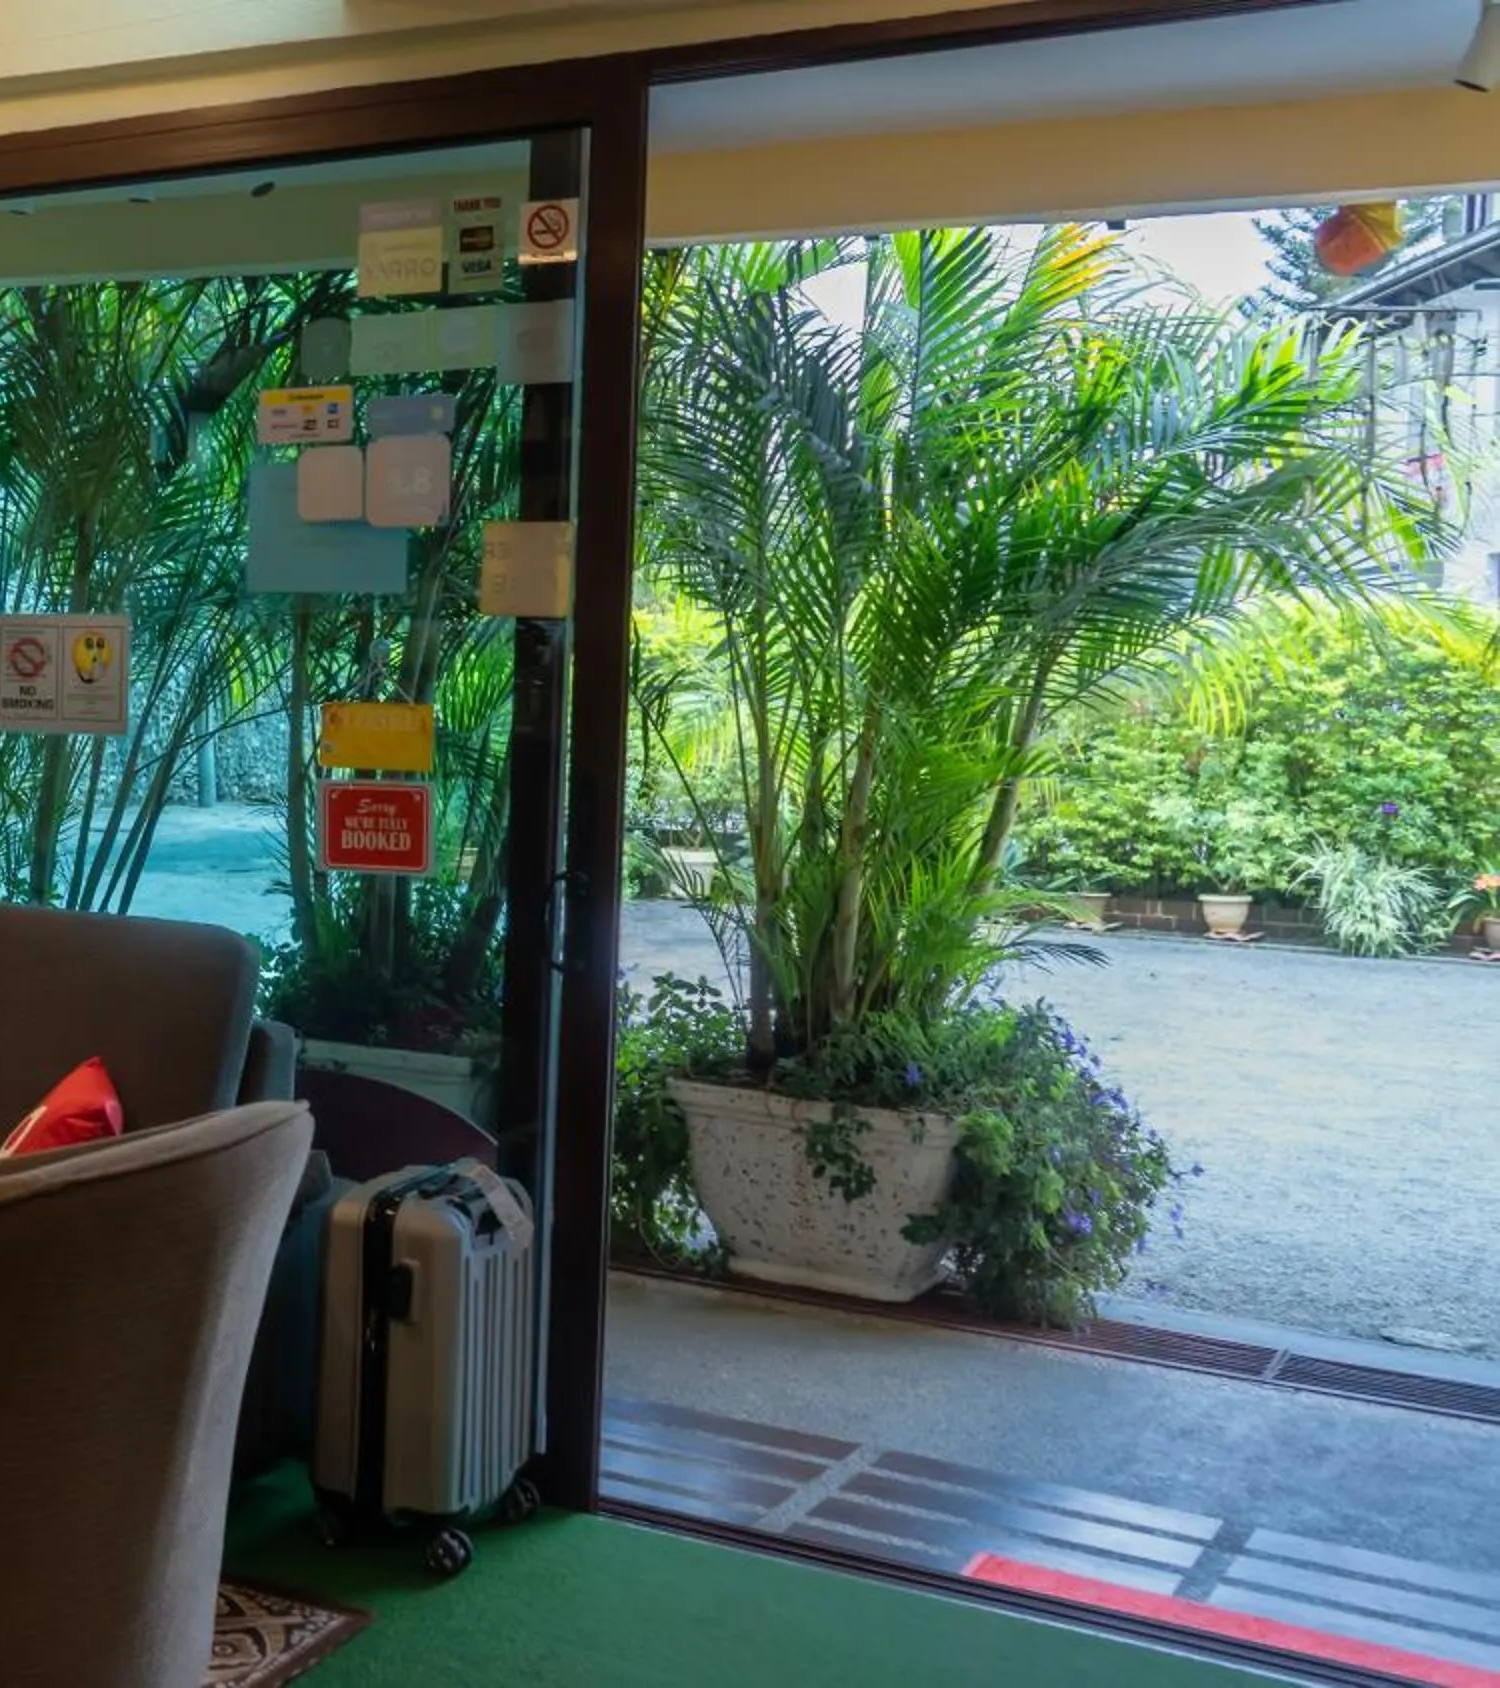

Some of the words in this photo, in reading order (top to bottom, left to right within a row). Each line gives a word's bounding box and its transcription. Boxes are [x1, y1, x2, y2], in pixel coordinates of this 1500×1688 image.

[462, 260, 492, 273] VISA
[19, 685, 37, 696] NO
[2, 697, 54, 709] SMOKING
[357, 799, 396, 815] Sorry
[379, 817, 408, 830] FULLY
[341, 830, 411, 851] BOOKED
